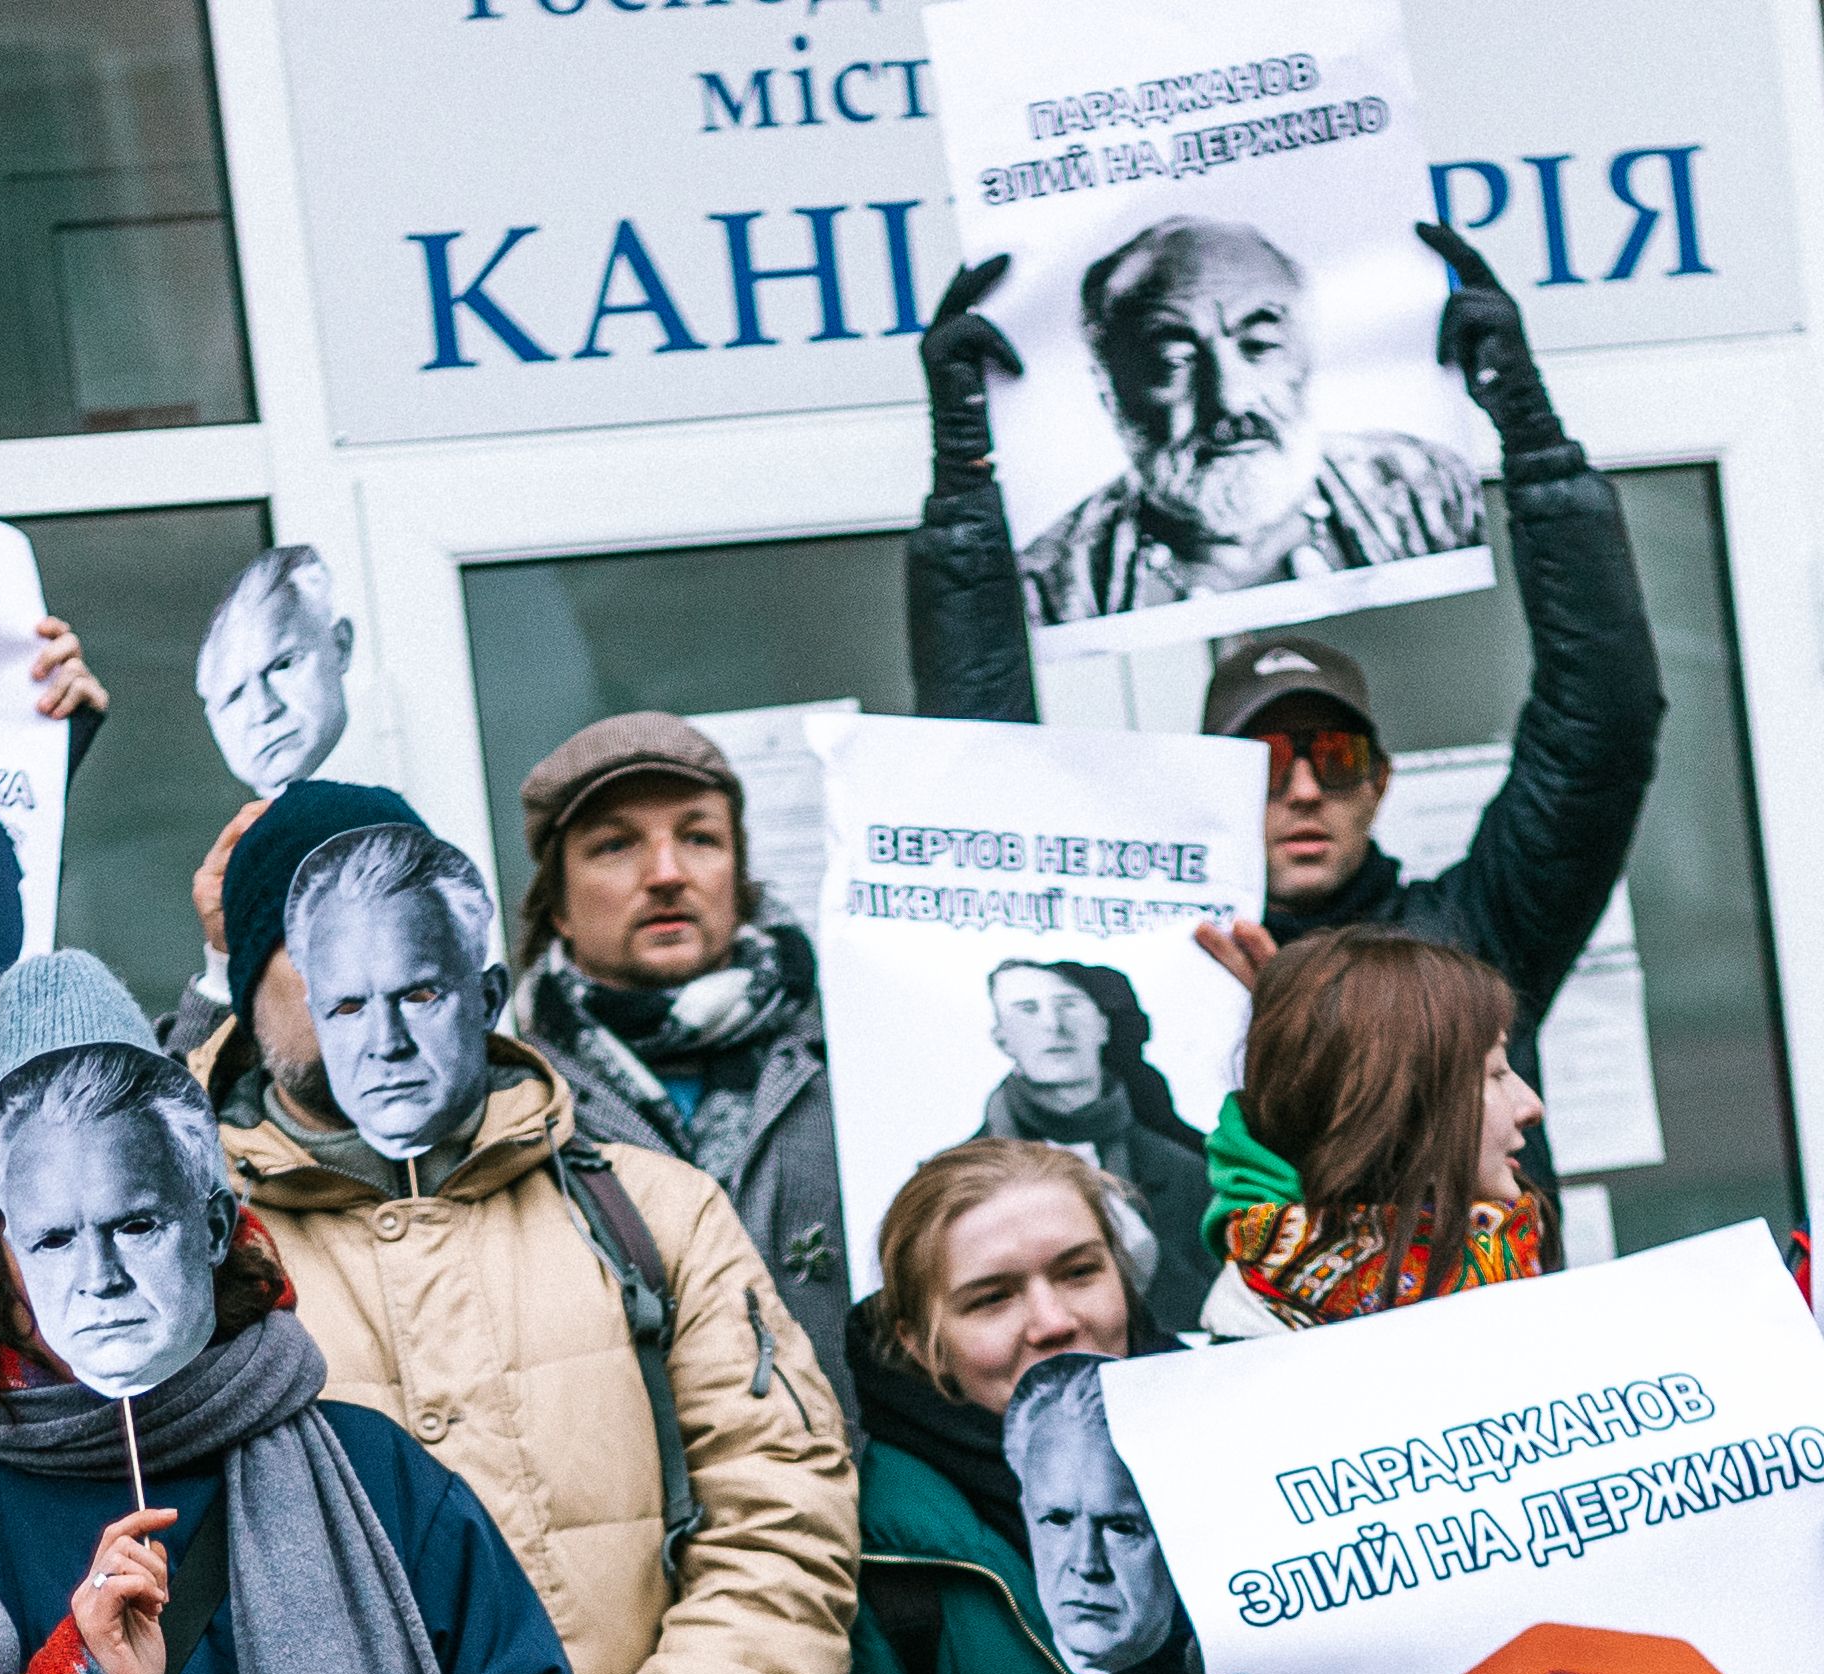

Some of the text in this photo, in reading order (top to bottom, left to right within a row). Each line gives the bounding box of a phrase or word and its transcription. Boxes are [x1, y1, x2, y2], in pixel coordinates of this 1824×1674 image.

[693, 34, 933, 133] міст
[1027, 52, 1320, 141] ПАРАДЖАНОВ
[980, 96, 1391, 205] ЗЛИЙ НА ДЕРЖКІНО
[868, 825, 1209, 883] ВЕРТОВ НЕ ХОЧЕ
[846, 880, 1066, 934] ЛІКВІДАЦІЇ
[1276, 1373, 1715, 1525] ПАРАДЖАНОВ
[1228, 1525, 1420, 1627] ЗЛИЙ
[1422, 1506, 1521, 1580] НА
